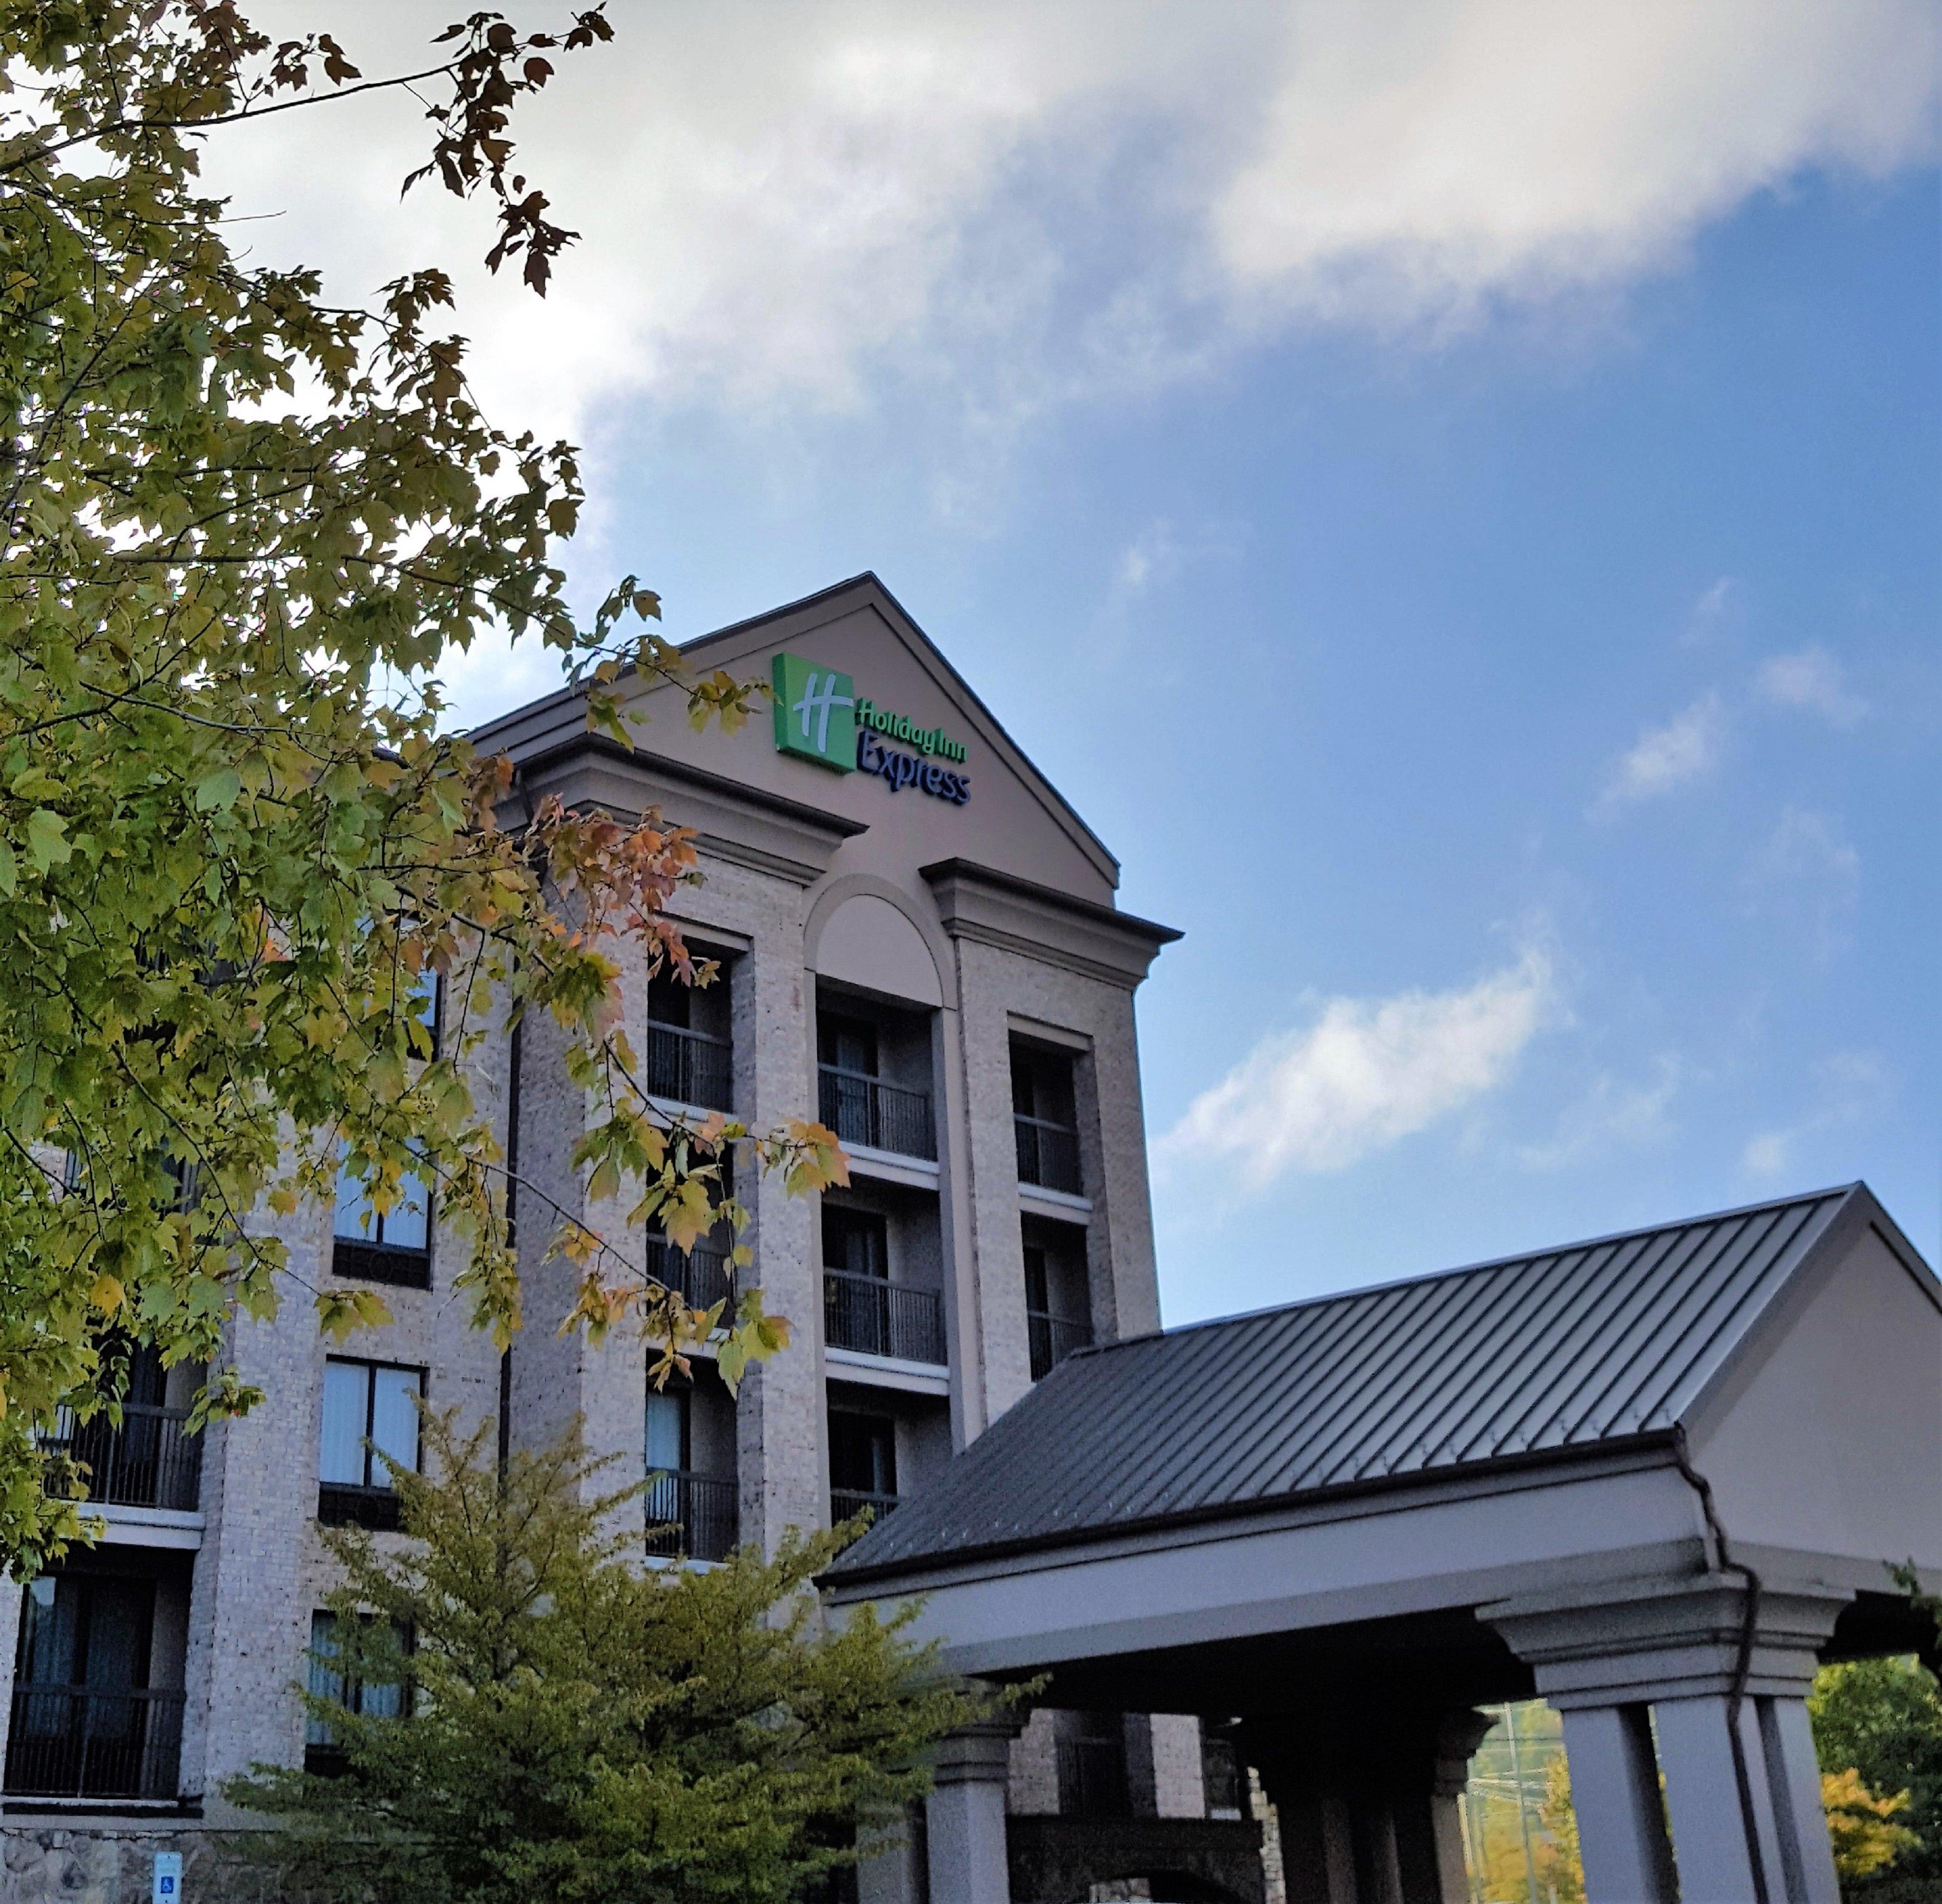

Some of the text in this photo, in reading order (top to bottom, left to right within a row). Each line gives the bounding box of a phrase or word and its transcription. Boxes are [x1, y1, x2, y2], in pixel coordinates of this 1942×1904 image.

[856, 698, 968, 764] Holiday Inn
[857, 731, 971, 805] Express
